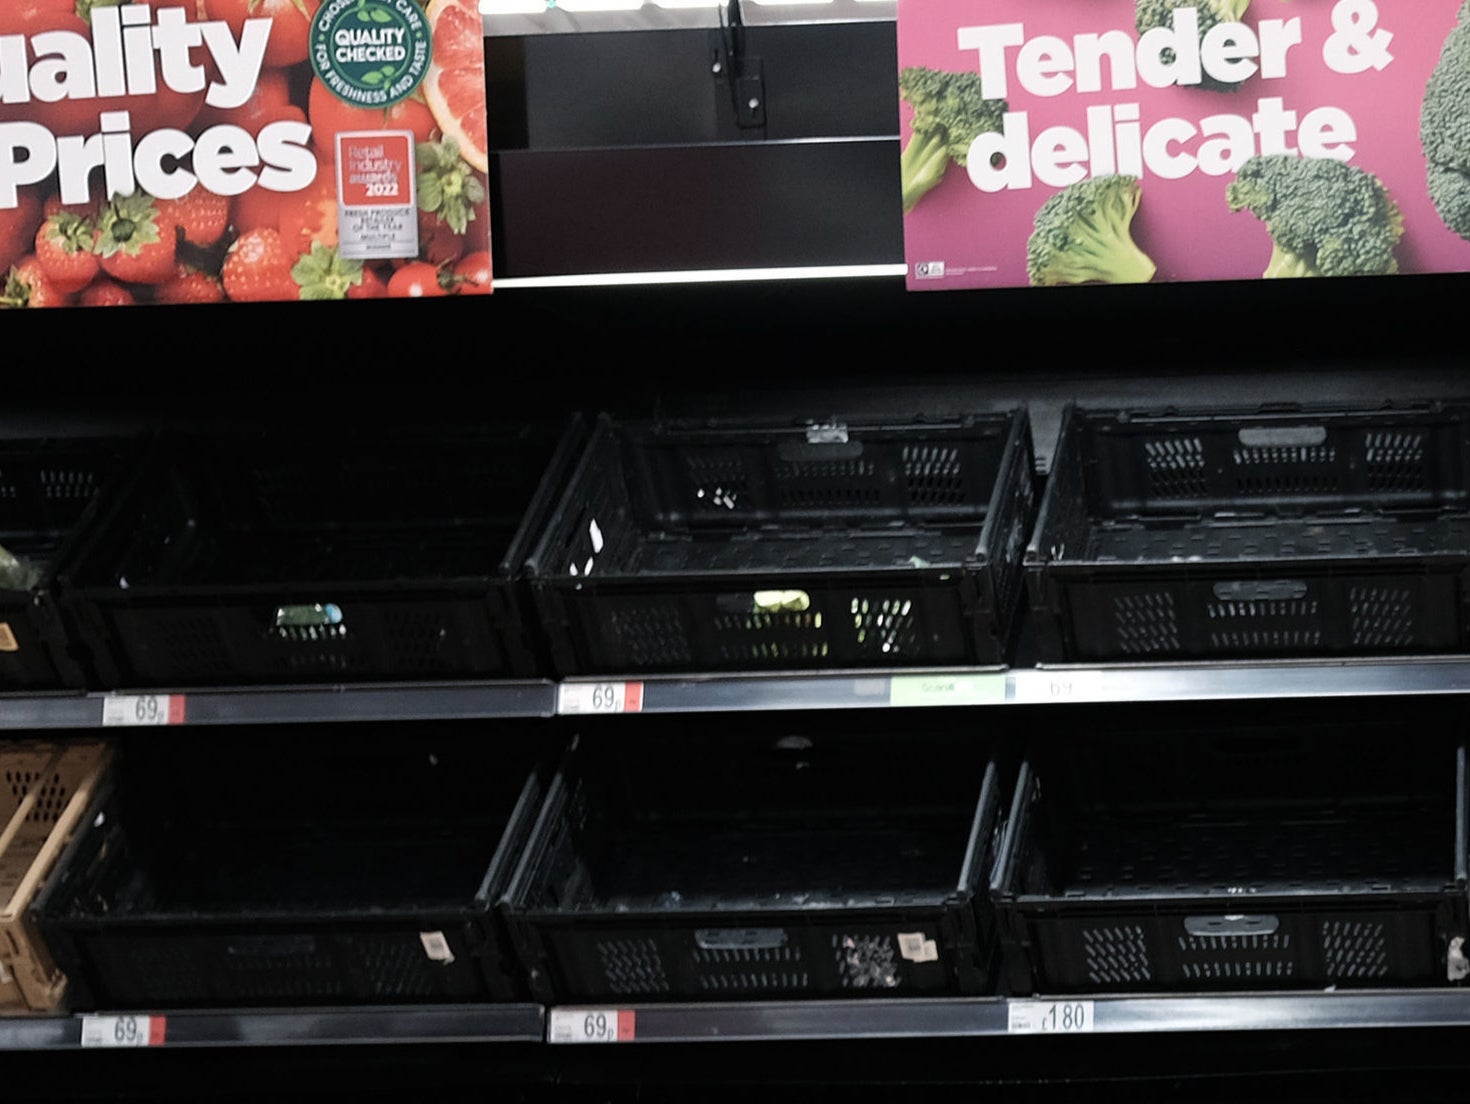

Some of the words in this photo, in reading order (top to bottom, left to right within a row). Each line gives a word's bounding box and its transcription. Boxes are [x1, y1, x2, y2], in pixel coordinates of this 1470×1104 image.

[335, 28, 405, 46] QUALITY
[335, 46, 406, 63] CHECKED
[957, 7, 1302, 99] Tender
[1322, 0, 1394, 75] &
[315, 43, 330, 71] FOR
[325, 70, 387, 104] FRESHNESS
[389, 74, 413, 99] AND
[409, 41, 427, 76] TASTE
[0, 111, 317, 209] Prices
[967, 97, 1357, 192] delicate
[366, 183, 399, 197] 2022
